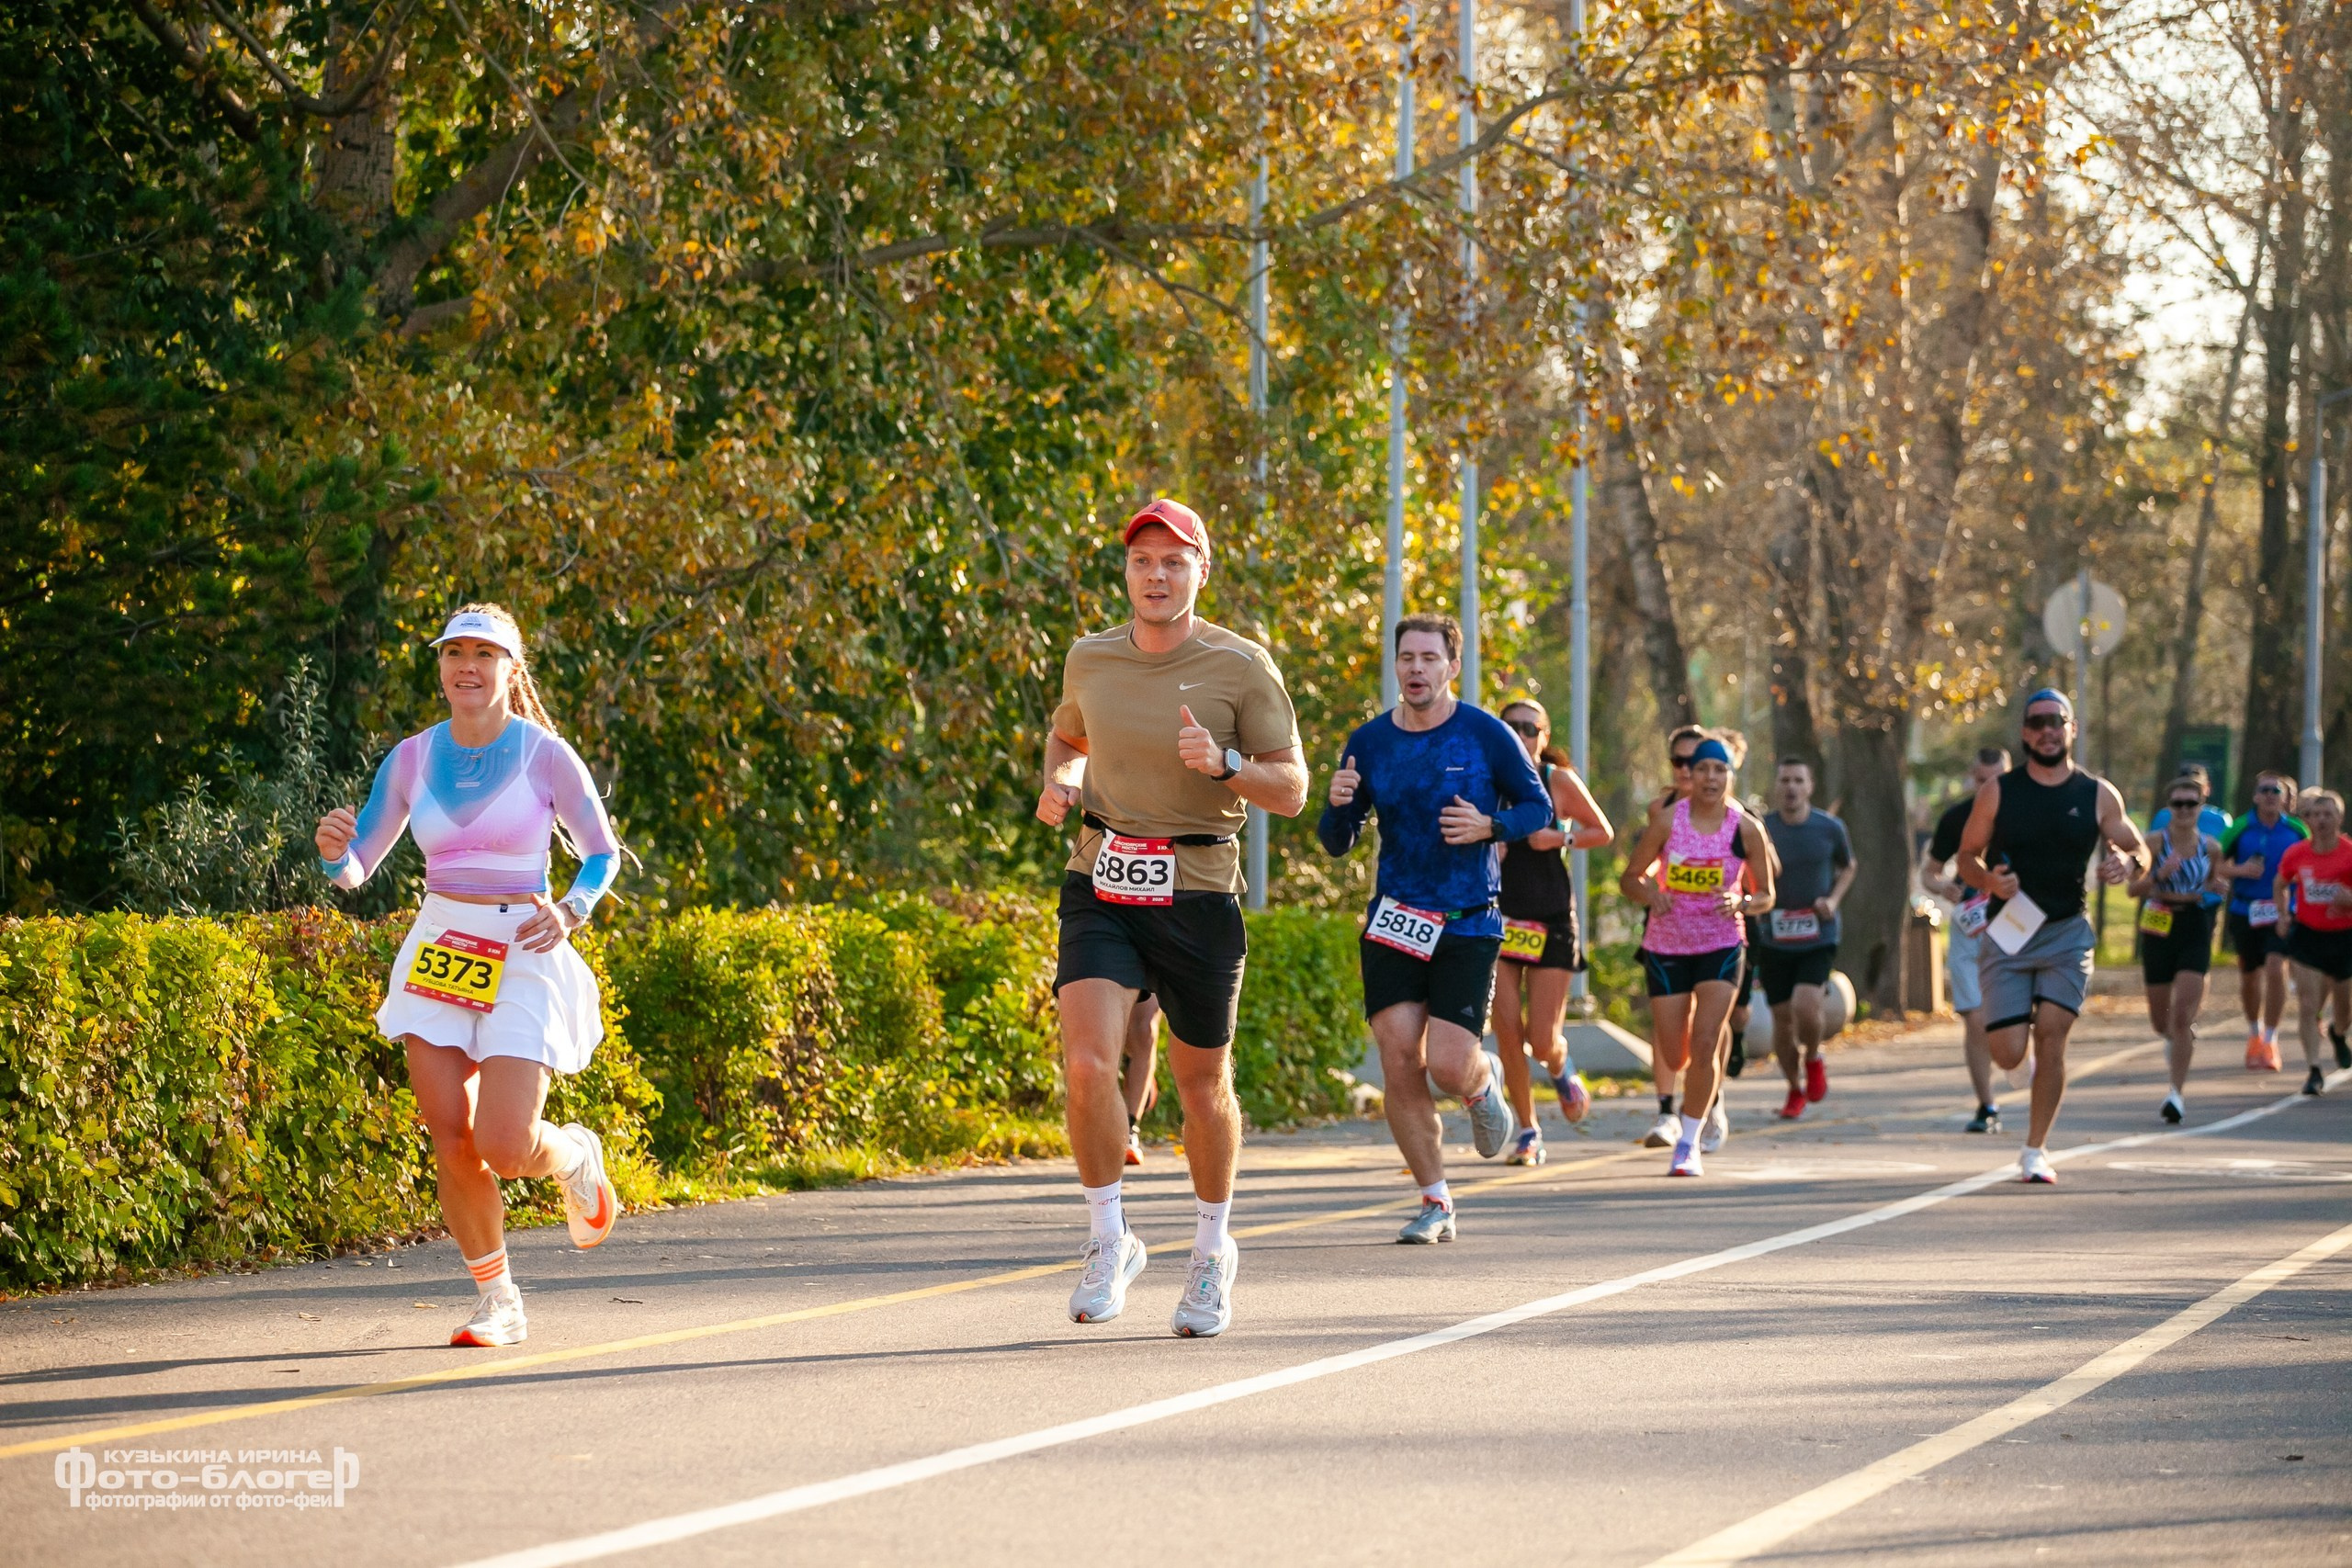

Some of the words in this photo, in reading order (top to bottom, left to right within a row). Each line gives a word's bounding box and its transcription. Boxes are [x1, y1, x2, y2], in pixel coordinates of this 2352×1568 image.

[1096, 852, 1169, 886] 5863
[1668, 866, 1720, 886] 5465
[1099, 881, 1128, 891] МИХАЙЛОВ
[1376, 910, 1434, 943] 5818
[1504, 930, 1542, 949] 090
[416, 947, 493, 989] 5373
[447, 983, 474, 995] ТАТЬЯНА
